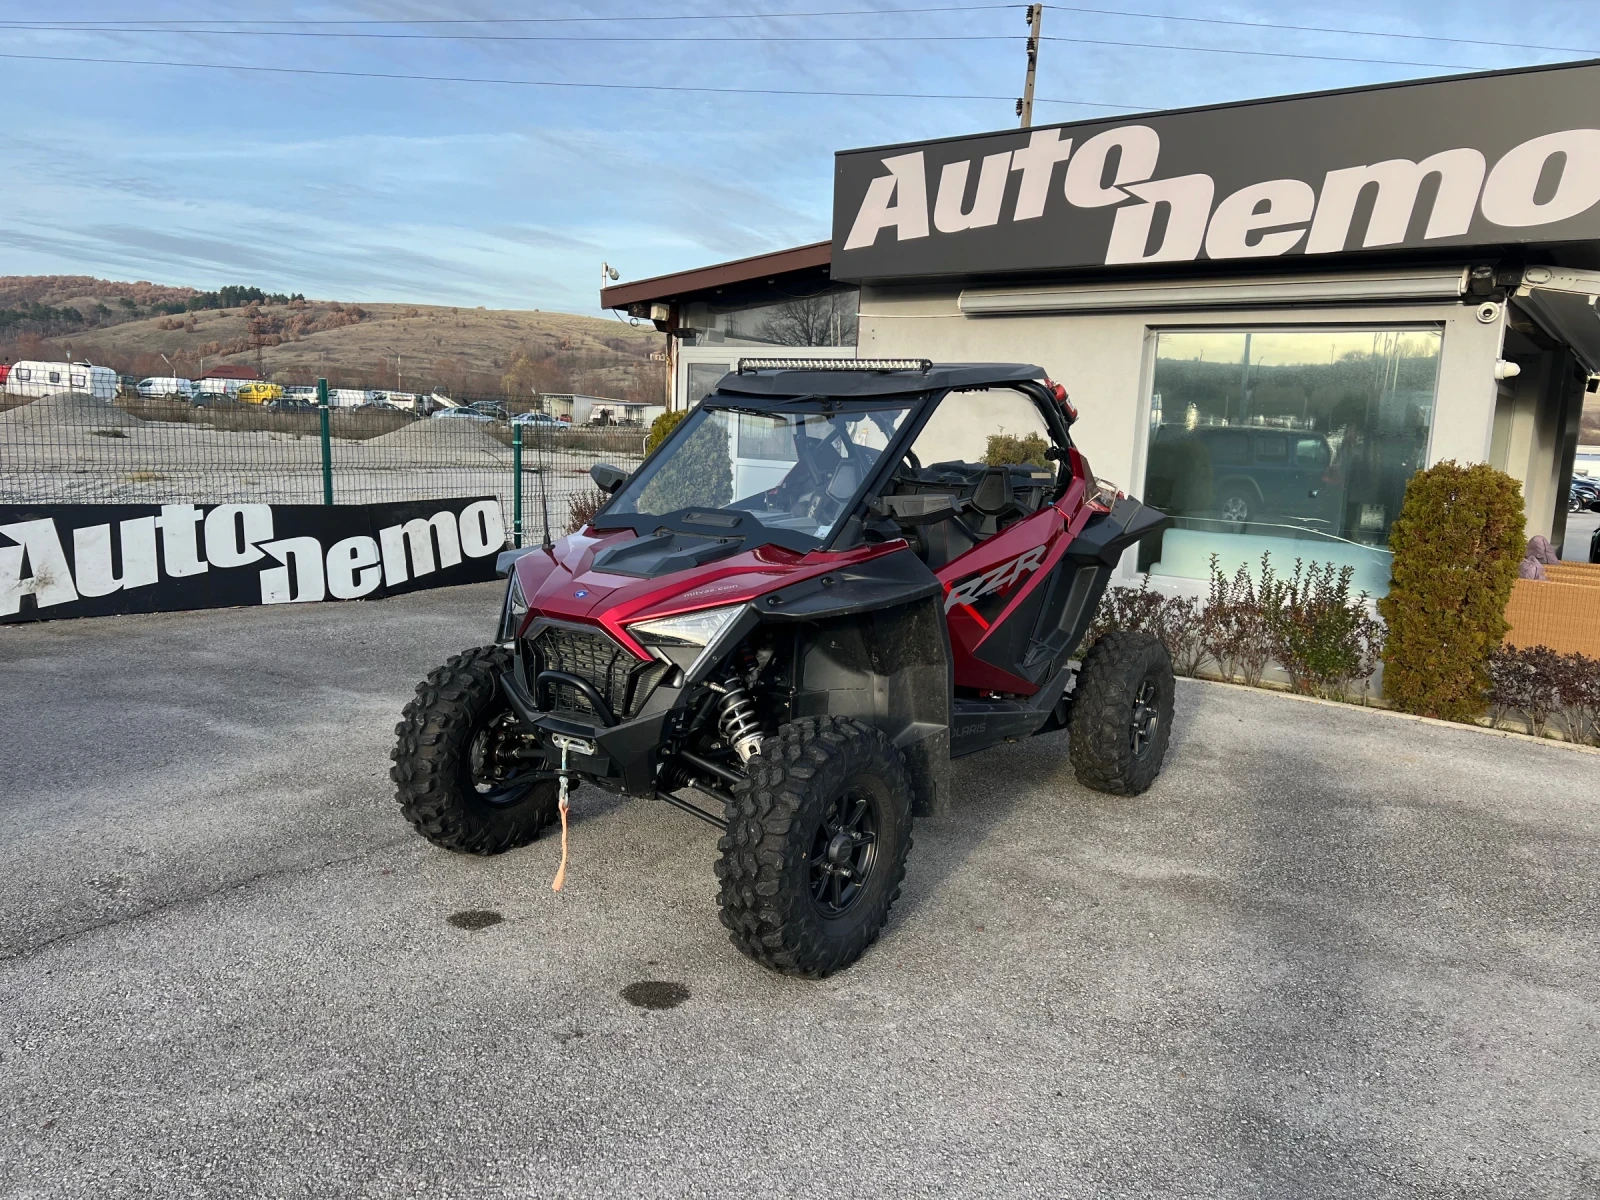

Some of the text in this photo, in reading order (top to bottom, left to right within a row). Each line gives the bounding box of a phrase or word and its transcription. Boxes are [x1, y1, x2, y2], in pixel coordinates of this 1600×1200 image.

[843, 124, 1600, 265] Auto Demo
[0, 499, 505, 616] Auto Demo
[944, 544, 1047, 616] RZR
